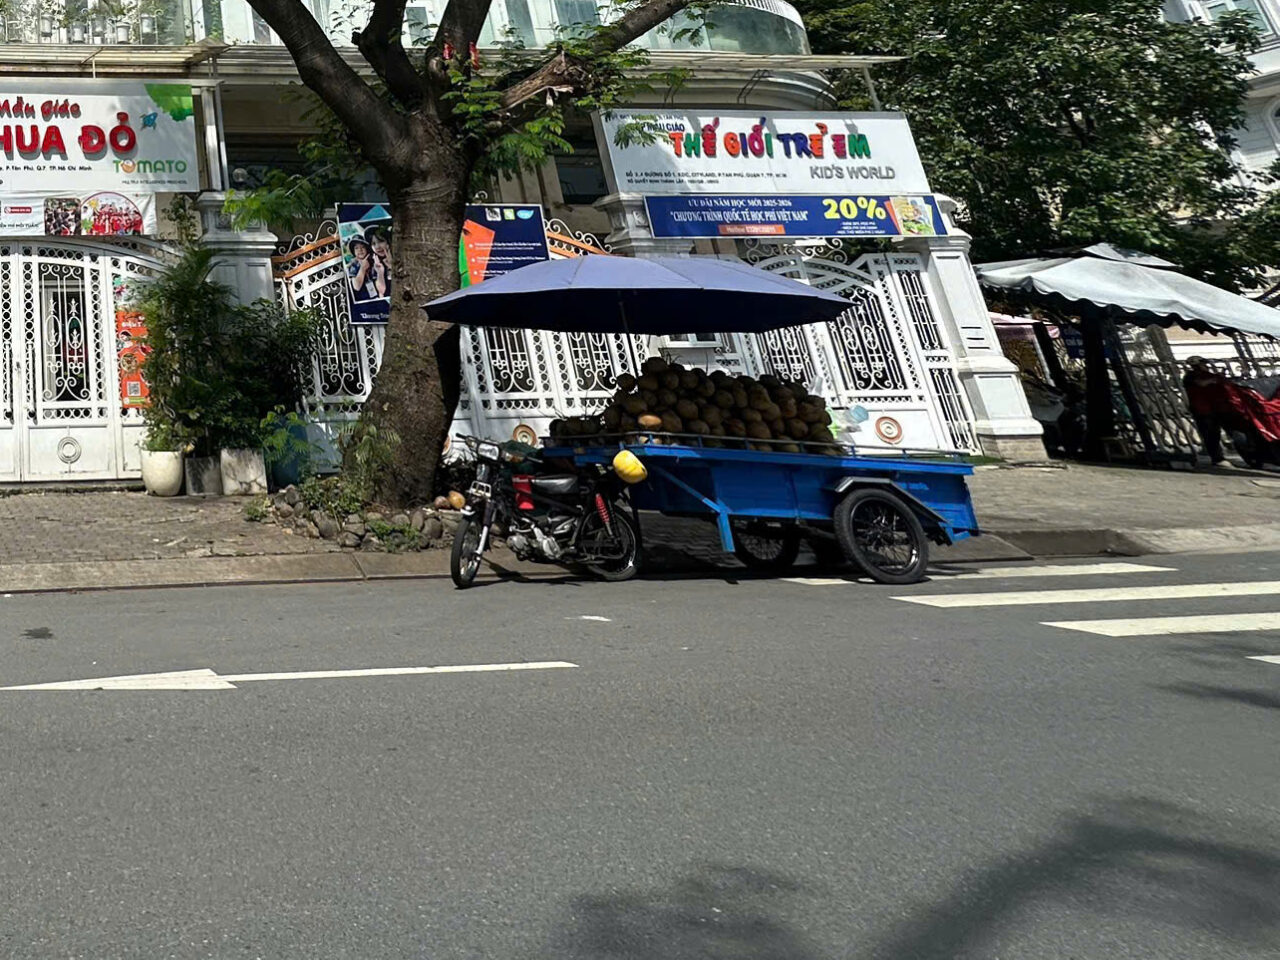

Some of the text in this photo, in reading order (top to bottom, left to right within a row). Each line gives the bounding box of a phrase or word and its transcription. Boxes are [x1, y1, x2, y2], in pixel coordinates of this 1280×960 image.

[78, 111, 138, 159] ĐỎ
[669, 117, 871, 159] THẾ GIỚI TRẺ EM
[810, 164, 896, 180] KID'S WORLD
[823, 197, 887, 220] 20%
